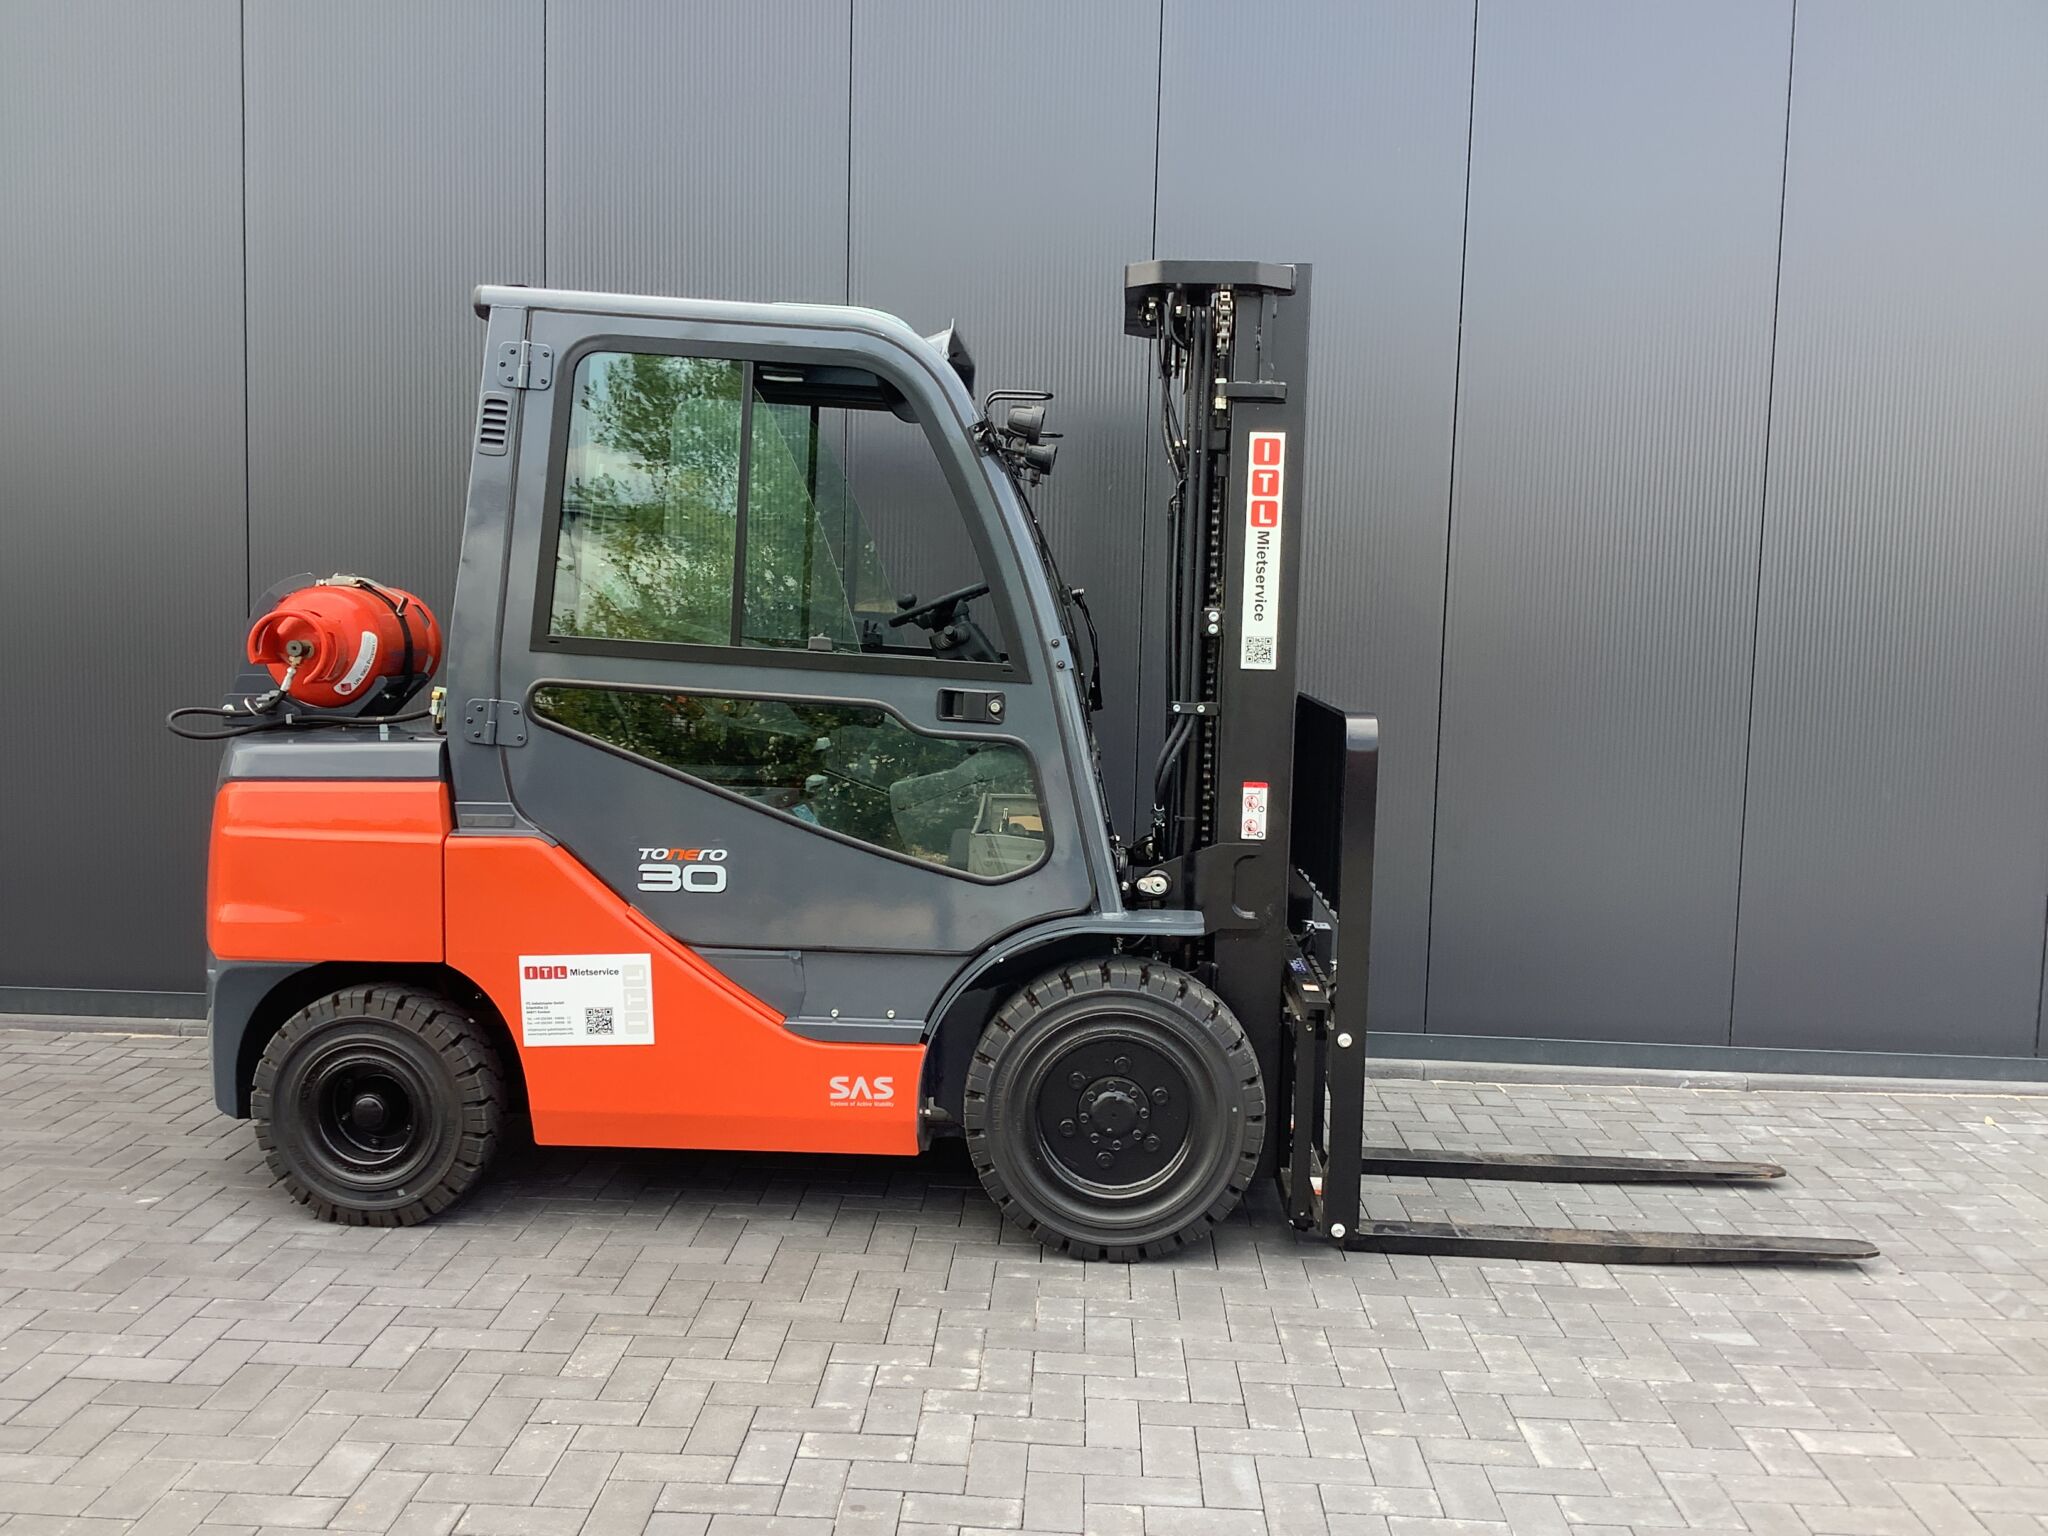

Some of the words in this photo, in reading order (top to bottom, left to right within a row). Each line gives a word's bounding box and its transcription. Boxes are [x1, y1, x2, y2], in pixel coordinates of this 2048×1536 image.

[1254, 440, 1276, 526] ITL
[1254, 531, 1270, 622] Mietservice
[637, 864, 727, 893] 30
[526, 966, 567, 979] ITL
[570, 968, 620, 977] Mietservice
[829, 1076, 895, 1100] SAS
